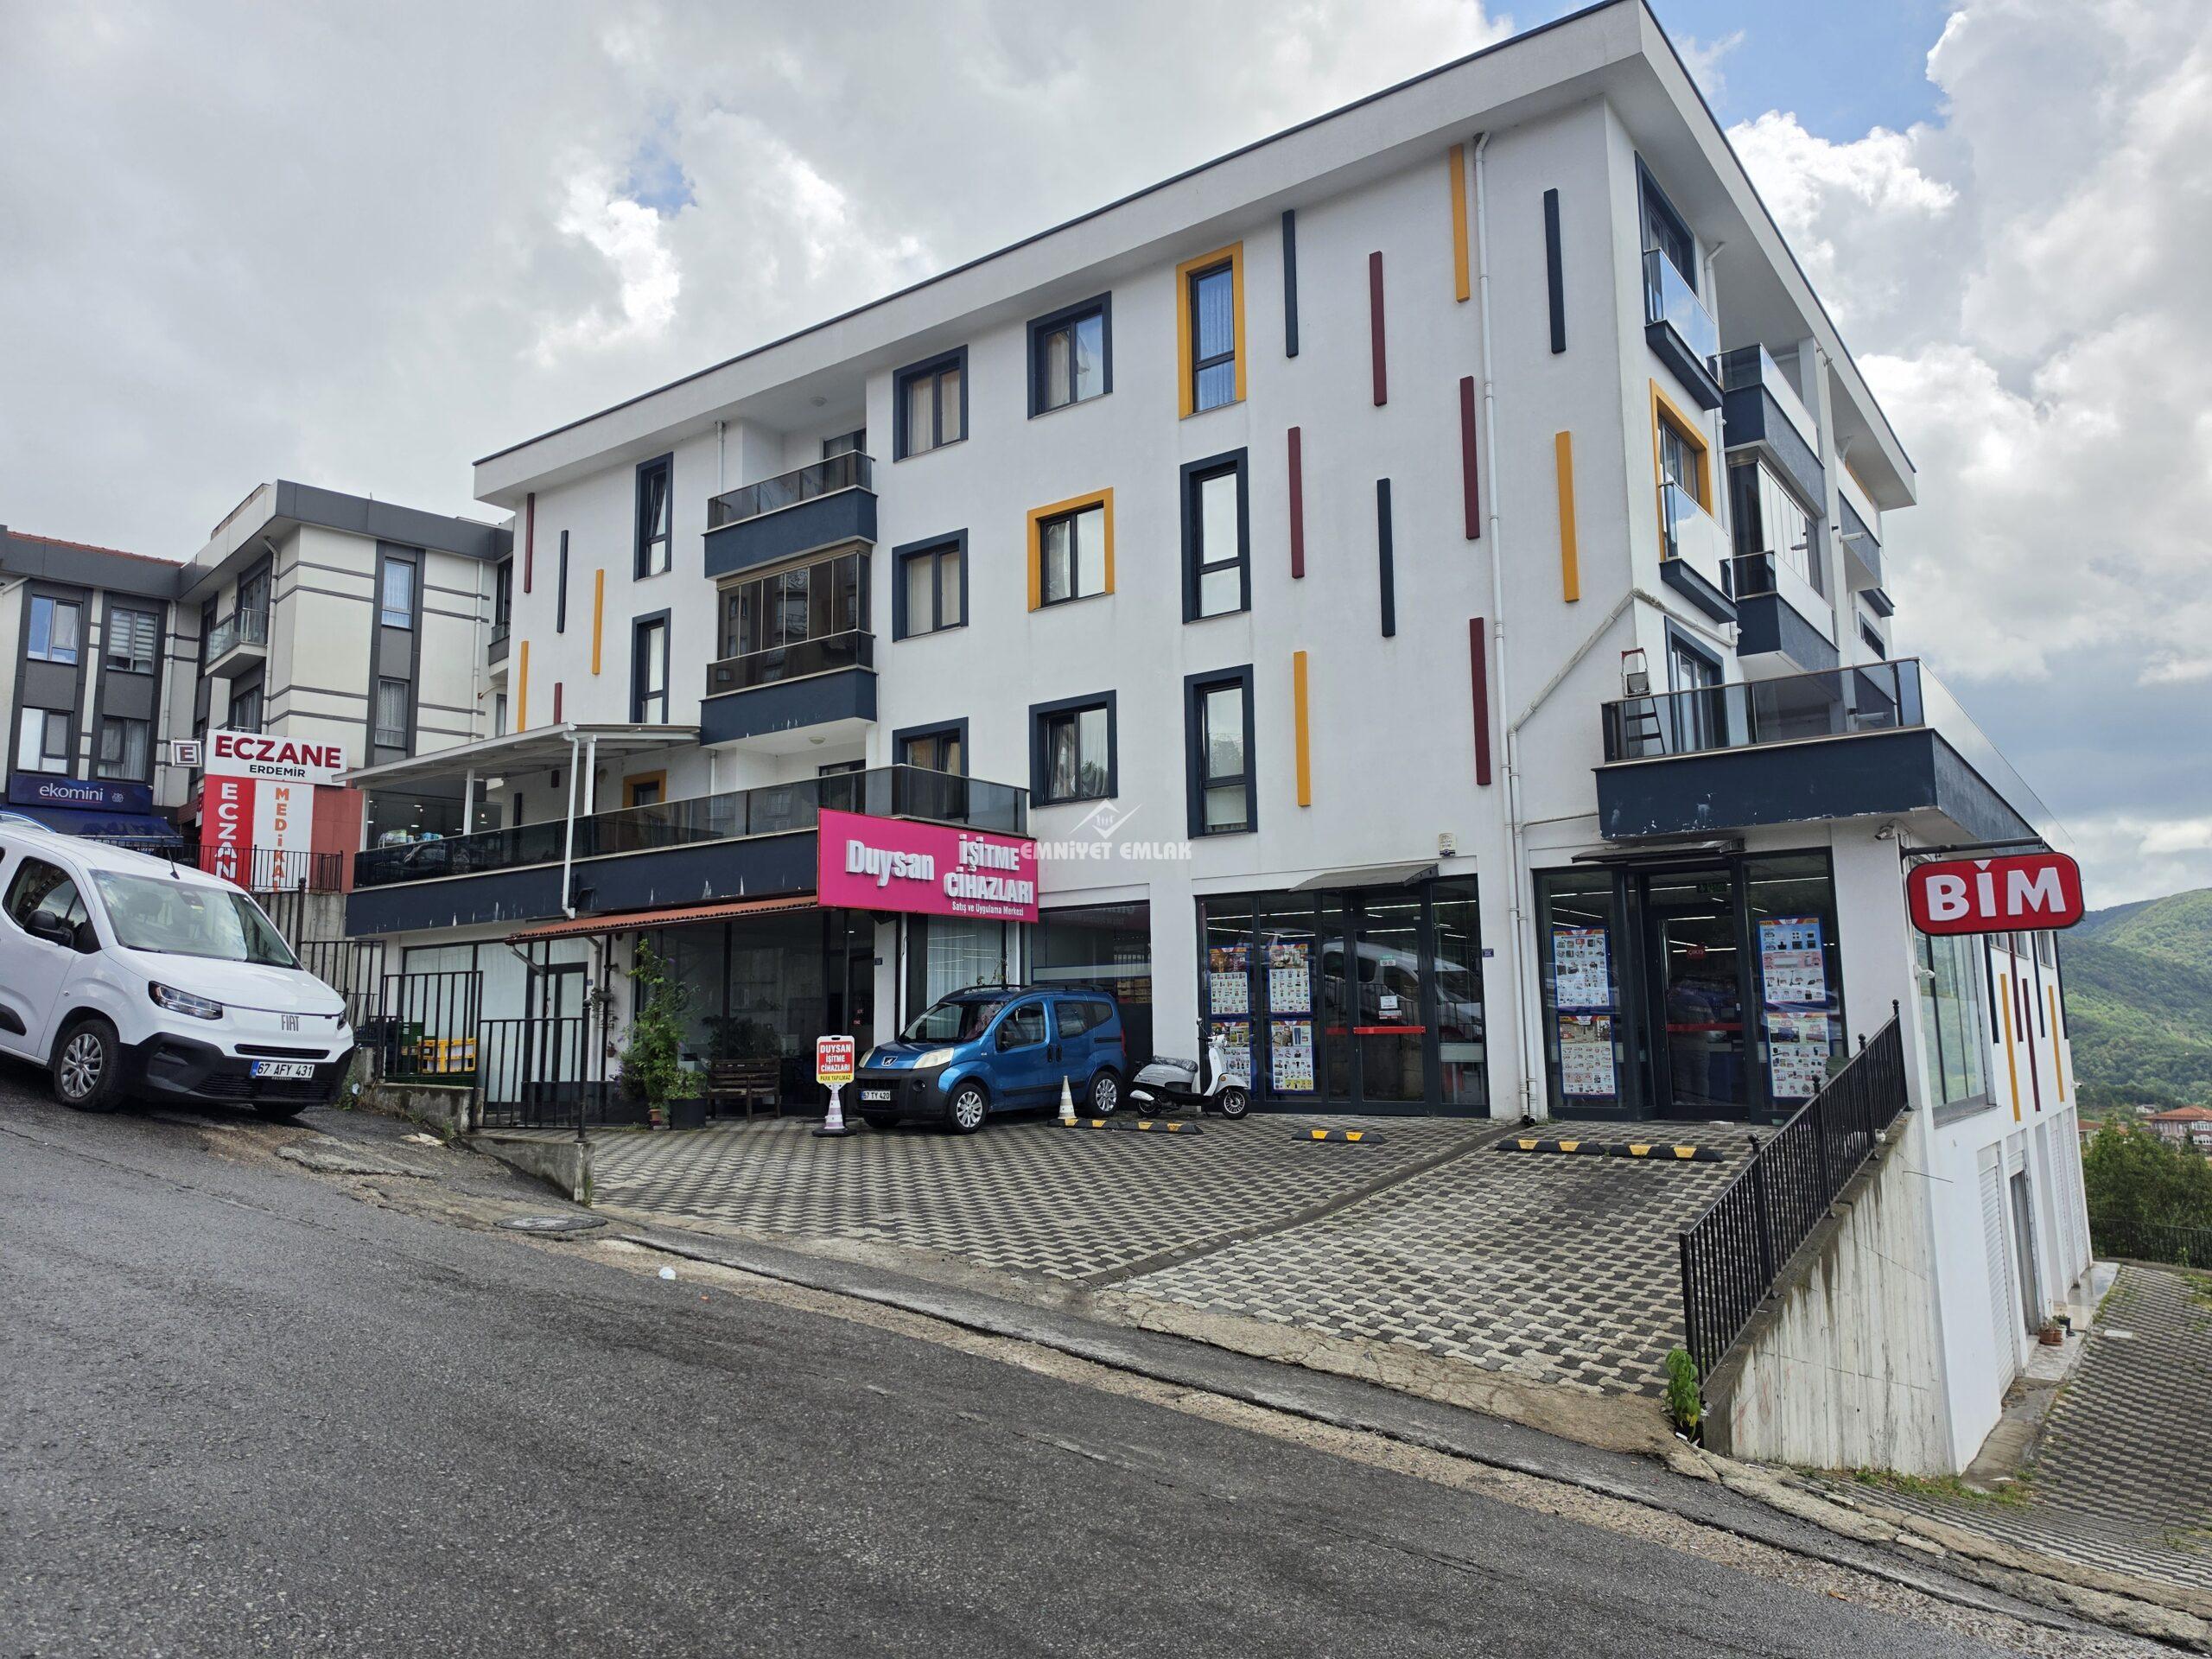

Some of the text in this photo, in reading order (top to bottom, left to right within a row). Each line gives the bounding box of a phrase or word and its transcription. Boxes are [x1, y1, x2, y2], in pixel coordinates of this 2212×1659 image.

[180, 747, 195, 761] E
[215, 734, 341, 769] ECZANE
[249, 765, 306, 778] ERDEMİR
[39, 783, 104, 801] ekomini
[214, 783, 238, 879] ECZAN
[958, 833, 1020, 871] İŞİTME
[845, 840, 935, 887] Duysan
[944, 867, 1033, 905] CİHAZLARI
[1925, 860, 2066, 921] BİM
[952, 901, 966, 913] Satış
[976, 904, 1001, 914] Uygulama
[1002, 906, 1024, 916] Merkezi
[281, 1014, 300, 1032] FIAT
[820, 1044, 851, 1053] DUYSAN
[257, 1063, 313, 1077] 67 AFY 431
